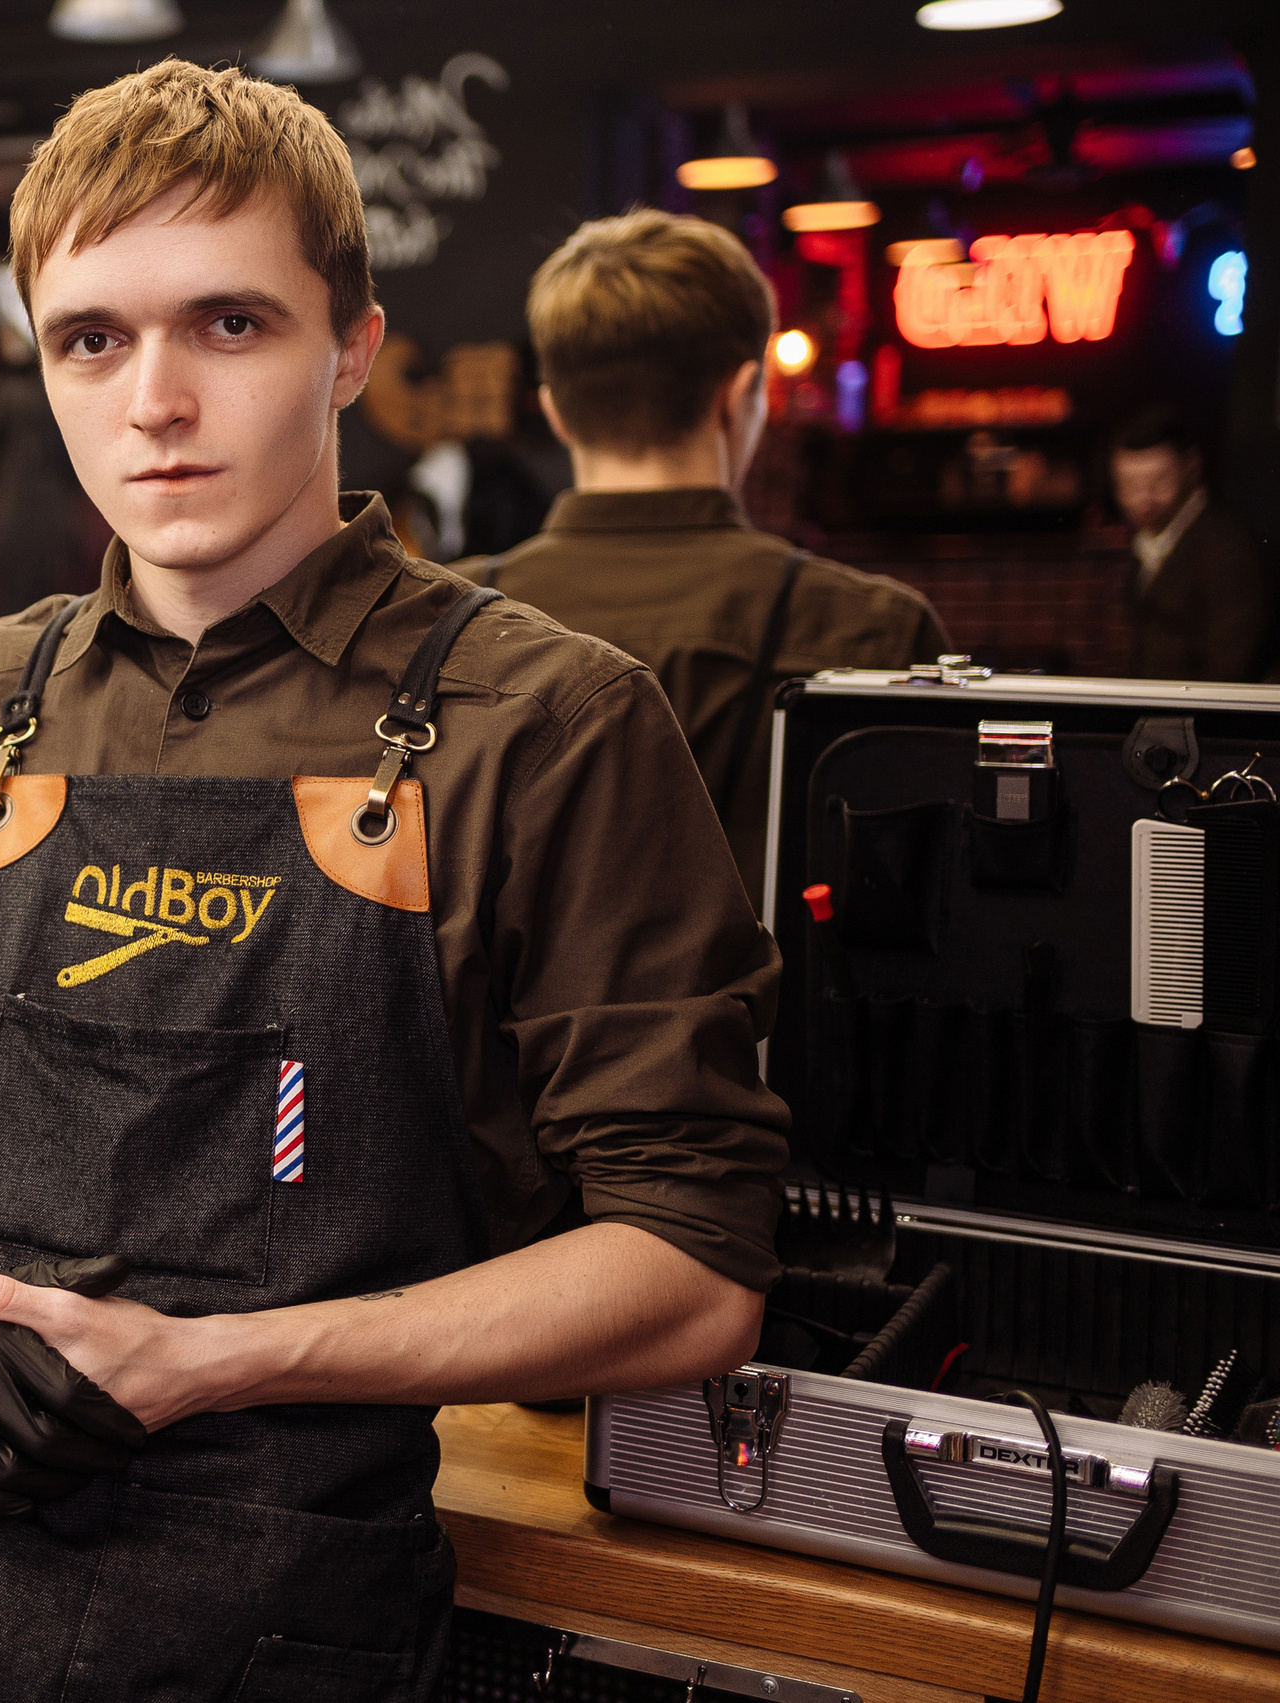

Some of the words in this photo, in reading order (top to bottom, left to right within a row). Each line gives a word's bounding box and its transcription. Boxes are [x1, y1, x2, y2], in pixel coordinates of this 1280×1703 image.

[196, 871, 282, 888] BARBERSHOP
[72, 864, 276, 943] OldBoy
[979, 1445, 1079, 1475] DEXTR
